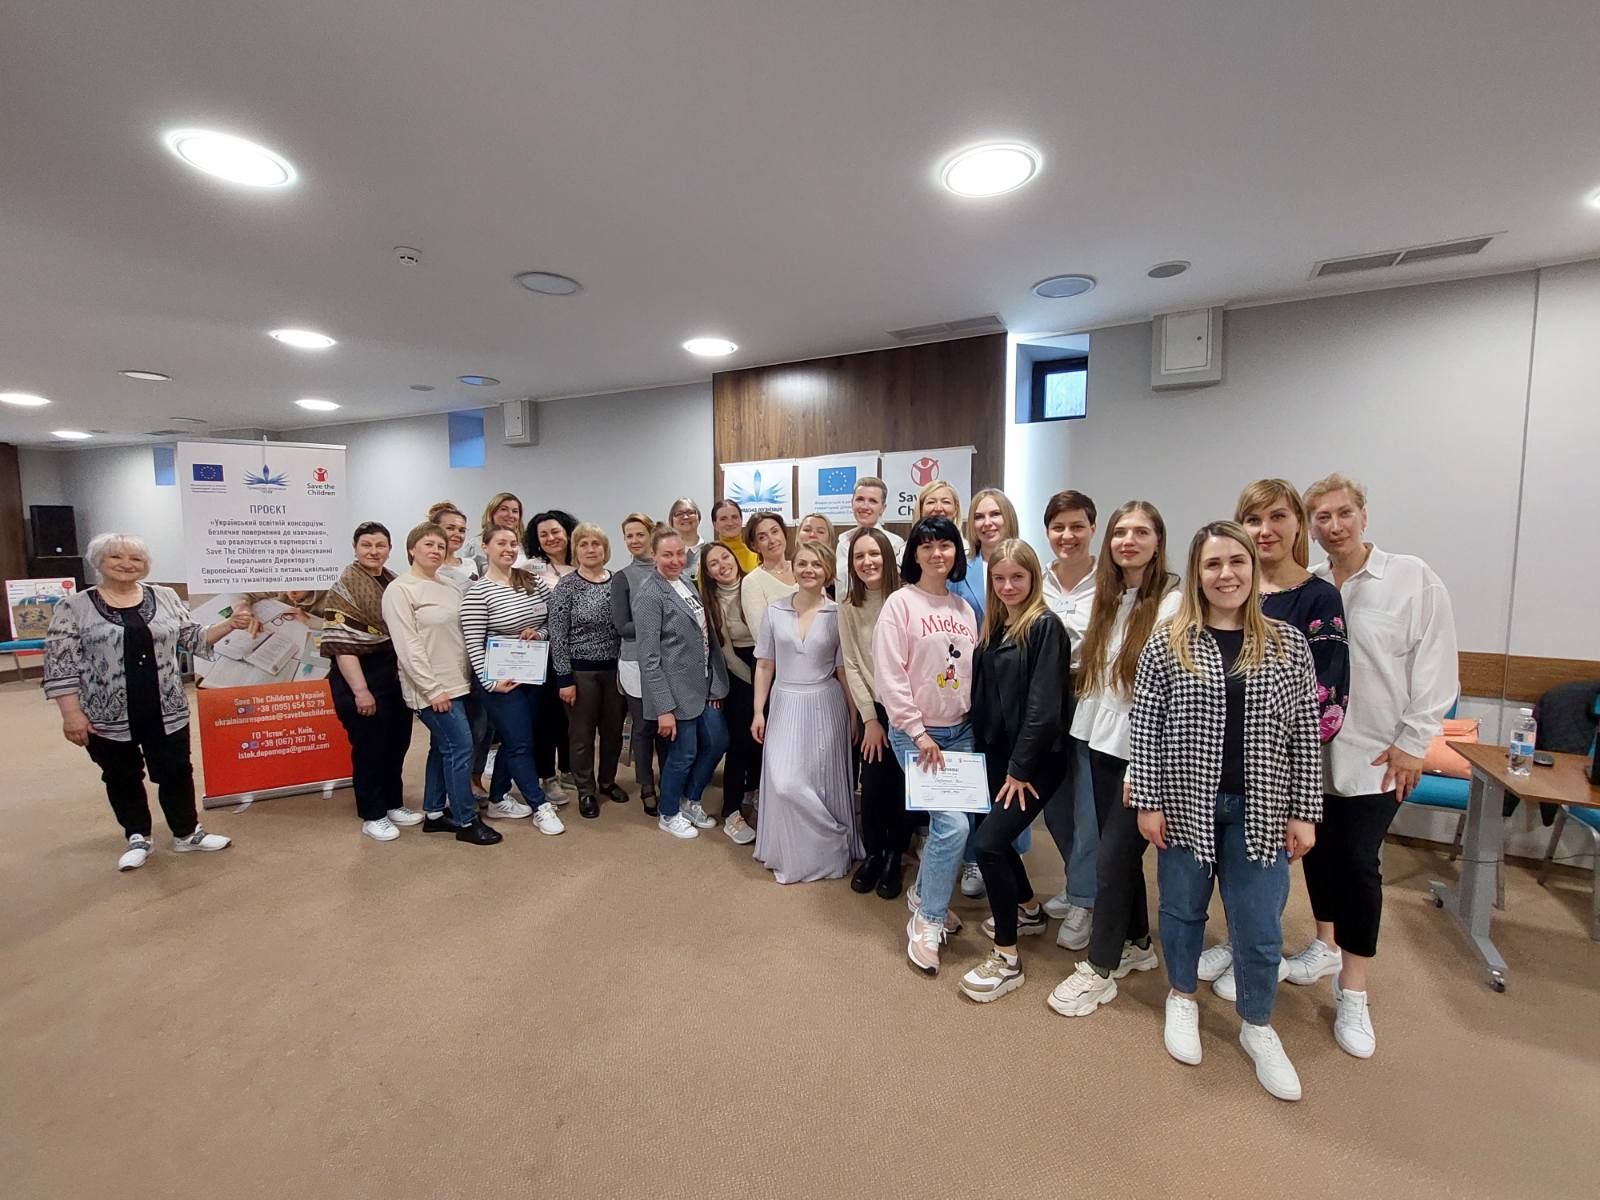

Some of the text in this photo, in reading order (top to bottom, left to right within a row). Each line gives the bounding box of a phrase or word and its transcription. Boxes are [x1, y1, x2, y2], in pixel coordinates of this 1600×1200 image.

[249, 504, 286, 514] ПРОЄКТ
[259, 519, 286, 527] освітній
[207, 528, 240, 536] безпечне
[228, 539, 272, 547] реалізується
[279, 538, 318, 546] партнерстві
[237, 547, 267, 555] Children
[290, 547, 333, 555] фінансуванні
[226, 557, 316, 565] Генерального Директорату
[920, 614, 976, 645] Mickey
[234, 697, 251, 706] Save
[251, 696, 265, 704] The
[265, 693, 294, 703] Children
[257, 699, 325, 713] +38 (095) 654 52 79
[260, 739, 274, 748] +38
[275, 736, 294, 748] (067)
[307, 734, 317, 743] 70
[317, 732, 327, 741] 42
